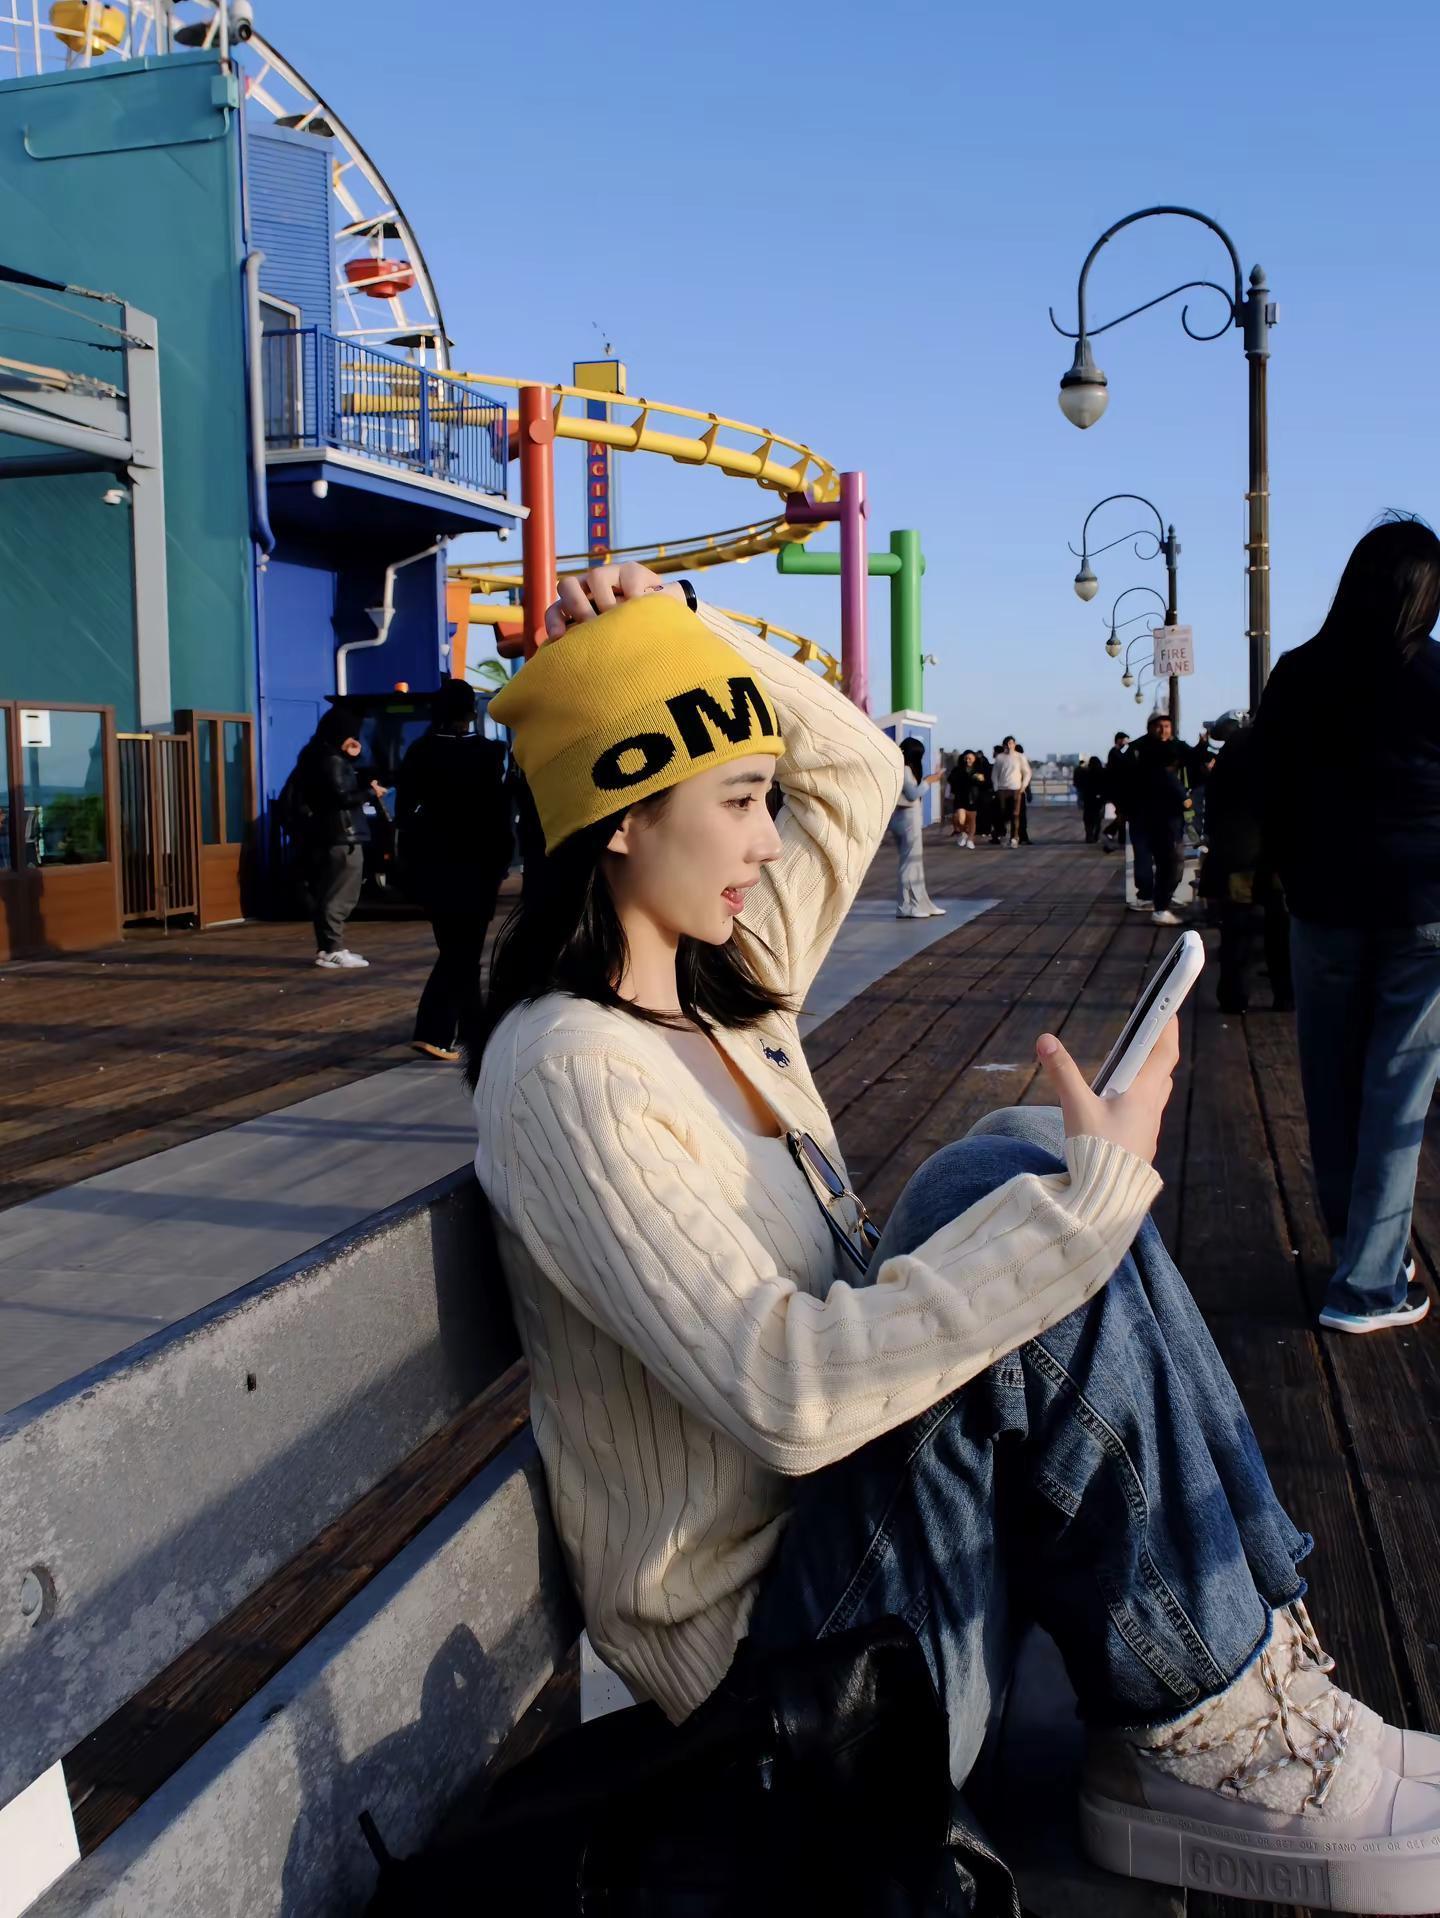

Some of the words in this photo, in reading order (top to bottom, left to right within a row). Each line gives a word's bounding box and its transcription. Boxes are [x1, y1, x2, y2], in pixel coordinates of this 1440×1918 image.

[1160, 647, 1187, 660] FIRE
[1159, 661, 1190, 674] LANE
[1324, 1842, 1357, 1852] STAND
[1362, 1841, 1380, 1852] OUT
